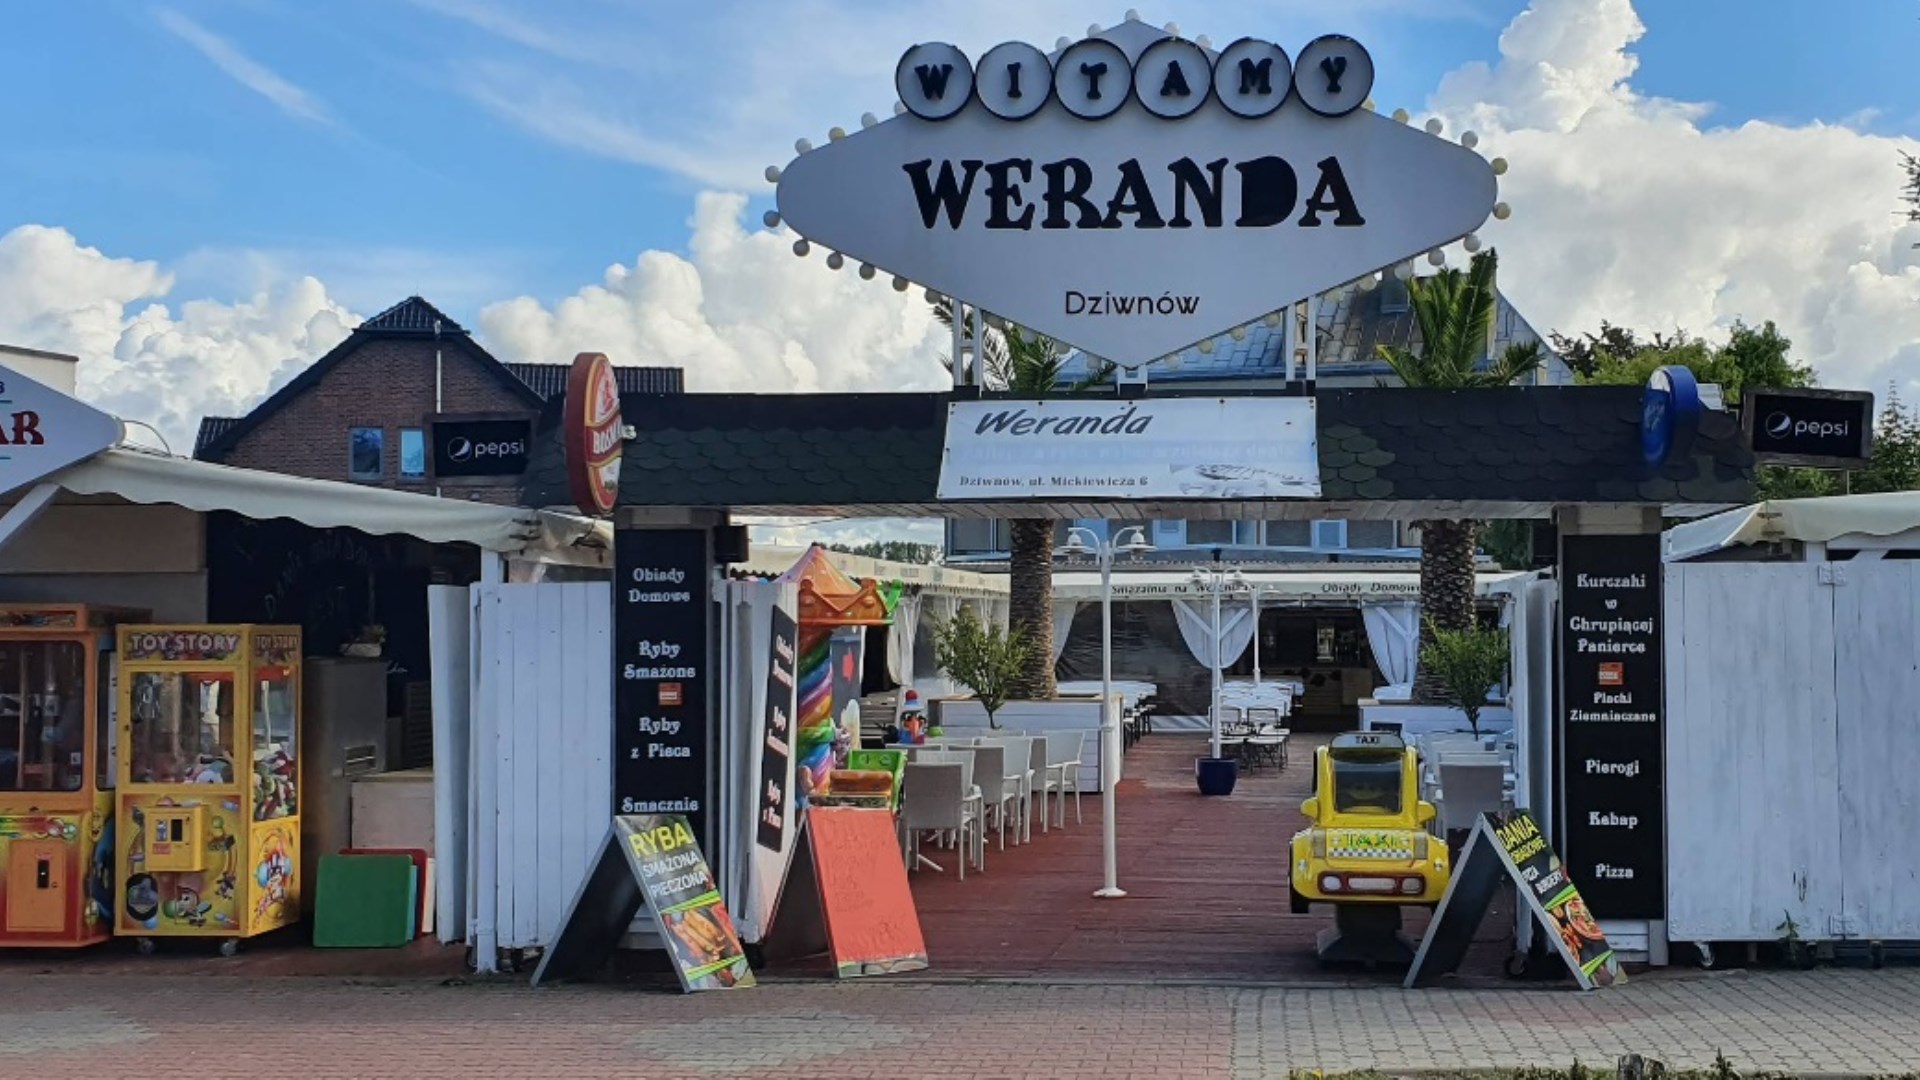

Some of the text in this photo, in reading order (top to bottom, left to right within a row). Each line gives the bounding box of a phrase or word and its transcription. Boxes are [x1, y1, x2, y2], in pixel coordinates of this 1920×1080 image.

[914, 56, 1348, 100] WITAMY
[902, 156, 1366, 230] WERANDA
[1064, 291, 1200, 316] Dziwnów
[974, 405, 1154, 436] Weranda
[1794, 419, 1849, 439] pepsi
[474, 438, 525, 459] pepsi
[1028, 475, 1045, 487] ul.
[1051, 475, 1136, 487] Mickiewicza
[1139, 476, 1149, 487] 6
[633, 567, 685, 584] Obiady
[1576, 573, 1646, 588] Kurczaki
[628, 588, 691, 603] Domowe
[1321, 582, 1361, 593] Obiady
[1604, 599, 1618, 610] w
[1569, 616, 1654, 635] Chrupiącej
[131, 633, 240, 651] TOY STORY
[639, 640, 681, 659] Ryby
[1577, 638, 1646, 653] Panierce
[623, 663, 696, 679] Smażone
[1593, 692, 1632, 704] Placki
[1569, 709, 1656, 722] Ziemniaczane
[639, 716, 681, 735] Ryby
[1355, 735, 1381, 745] TAXI
[630, 743, 691, 759] z Pieca
[1585, 759, 1640, 777] Pierogi
[621, 796, 699, 813] Smacznie
[1588, 811, 1639, 829] Kebap
[628, 822, 693, 859] RYBA
[1342, 832, 1398, 848] TAXI
[1495, 814, 1540, 851] DANIA
[1595, 863, 1634, 879] Pizza
[650, 871, 709, 898] PIECZONA
